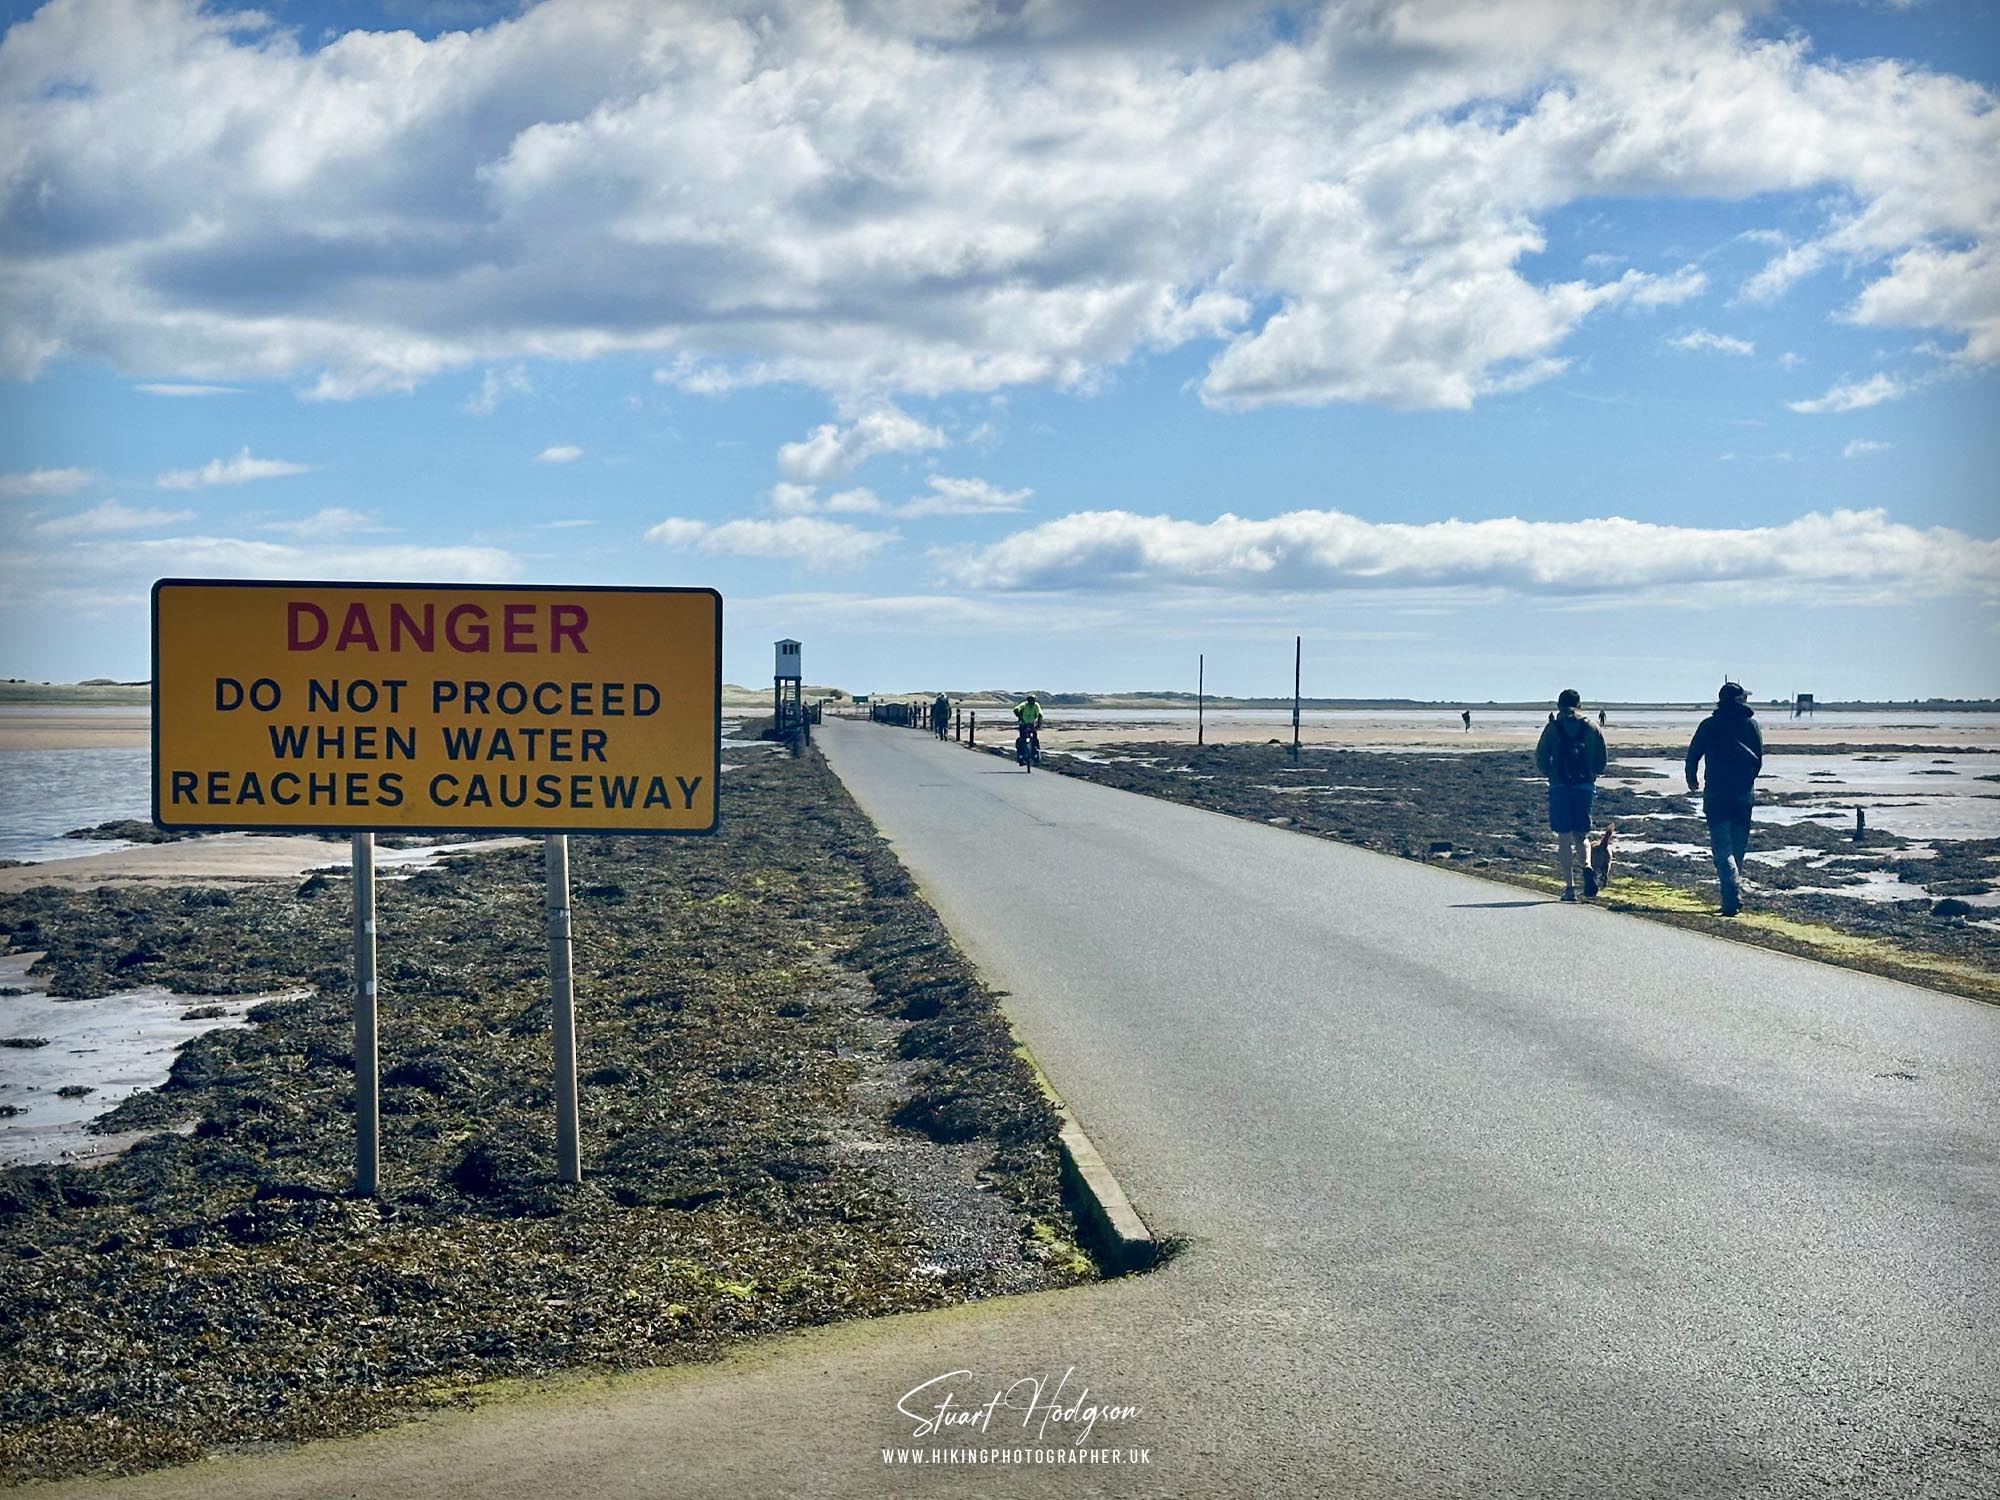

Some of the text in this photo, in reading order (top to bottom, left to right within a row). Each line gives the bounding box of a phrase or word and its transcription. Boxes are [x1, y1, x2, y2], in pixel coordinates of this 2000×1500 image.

[287, 602, 589, 654] DANGER
[215, 678, 661, 716] DO NOT PROCEED
[269, 725, 608, 762] WHEN WATER
[171, 771, 702, 810] REACHES CAUSEWAY
